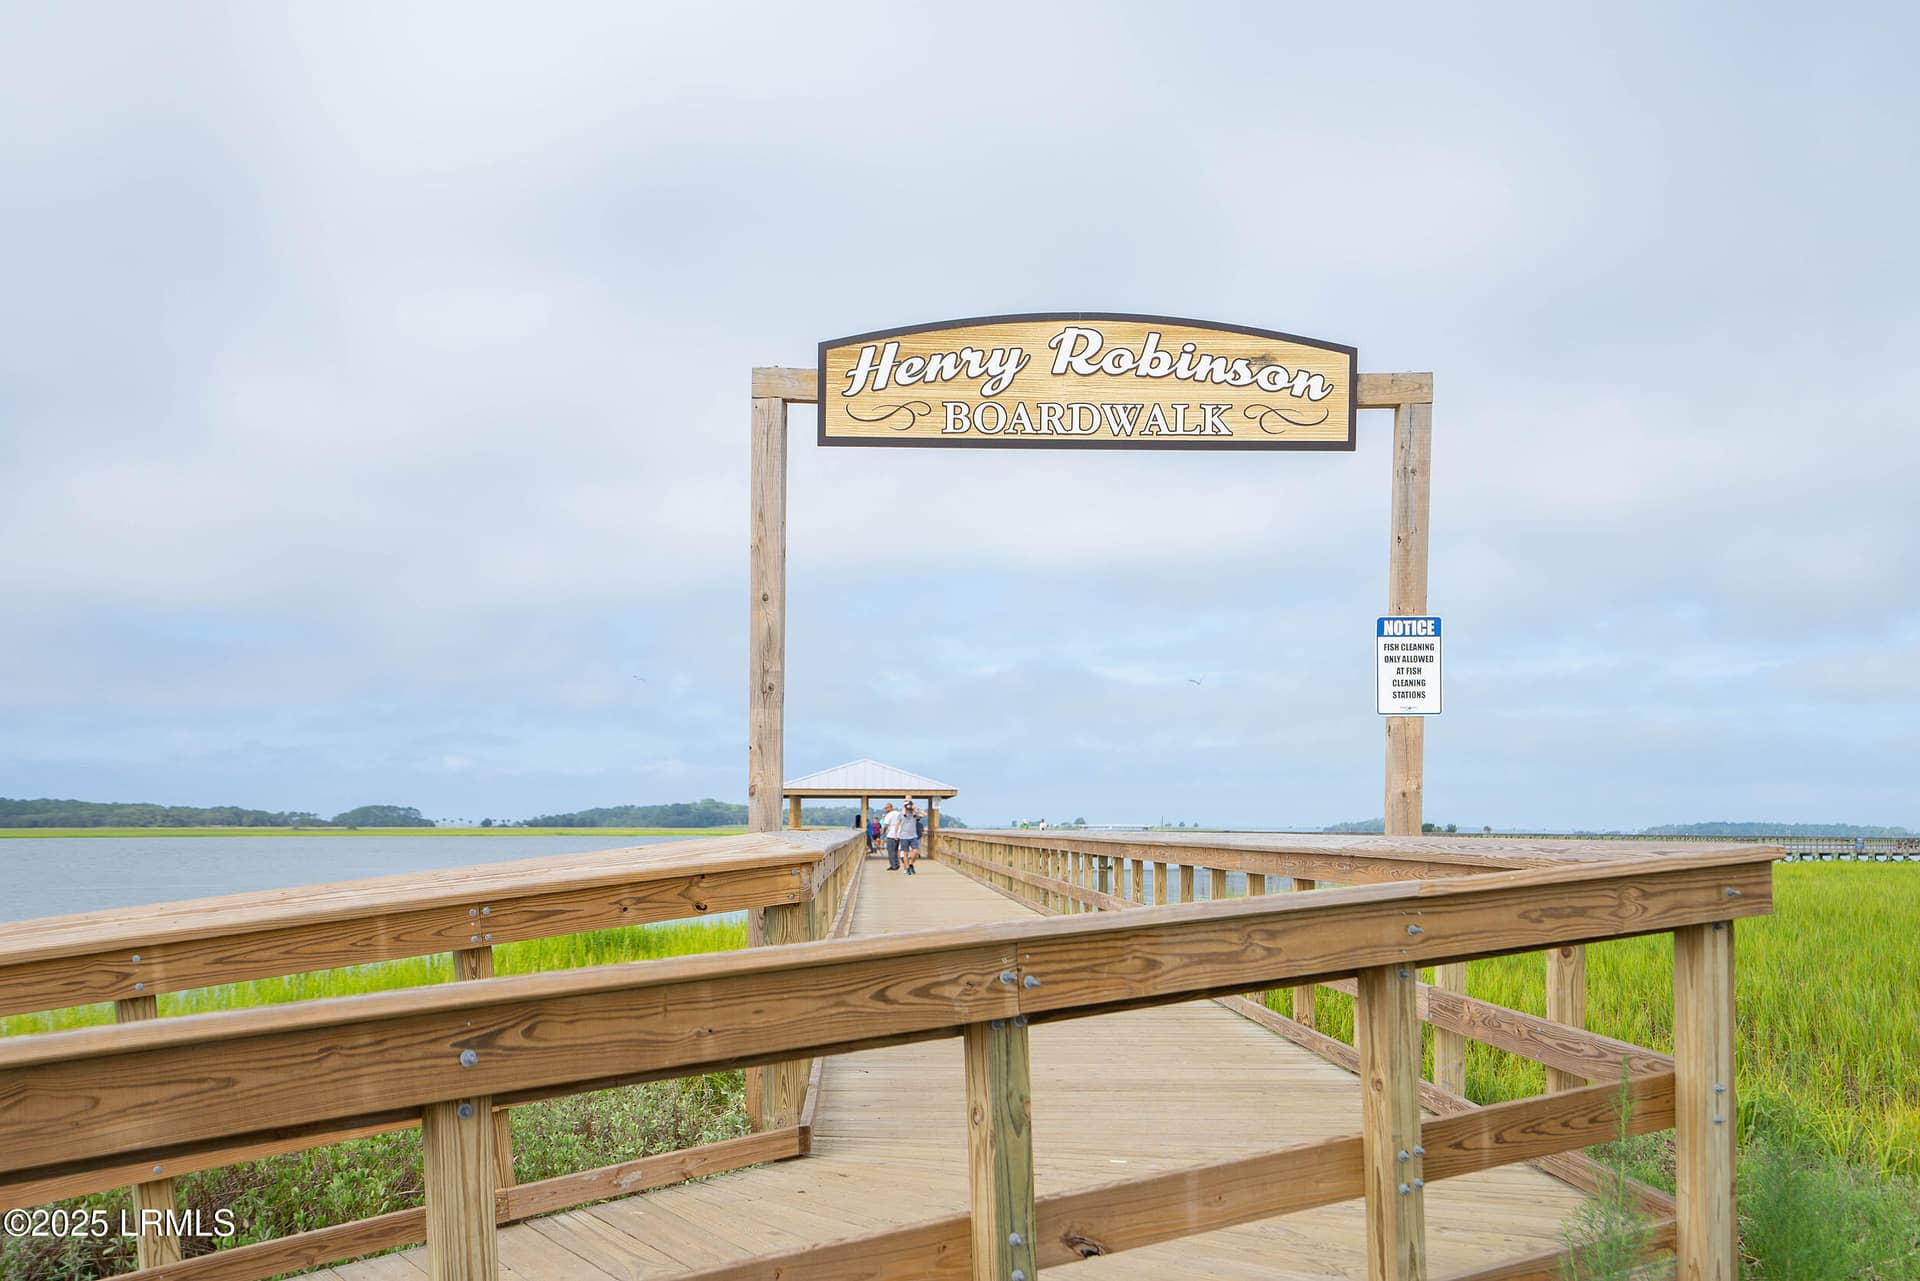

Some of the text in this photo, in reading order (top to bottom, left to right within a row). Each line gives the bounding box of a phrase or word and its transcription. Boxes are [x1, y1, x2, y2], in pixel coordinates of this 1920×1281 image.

[841, 326, 1335, 401] Henry Robinson
[942, 402, 1234, 436] BOARDWALK
[1383, 620, 1435, 636] NOTICE
[1383, 643, 1435, 651] FISH CLEANING
[1384, 655, 1434, 663] ONLY ALLOWED
[1396, 667, 1422, 675] AT FISH
[1392, 679, 1426, 687] CLEANING
[1392, 691, 1426, 699] STATIONS
